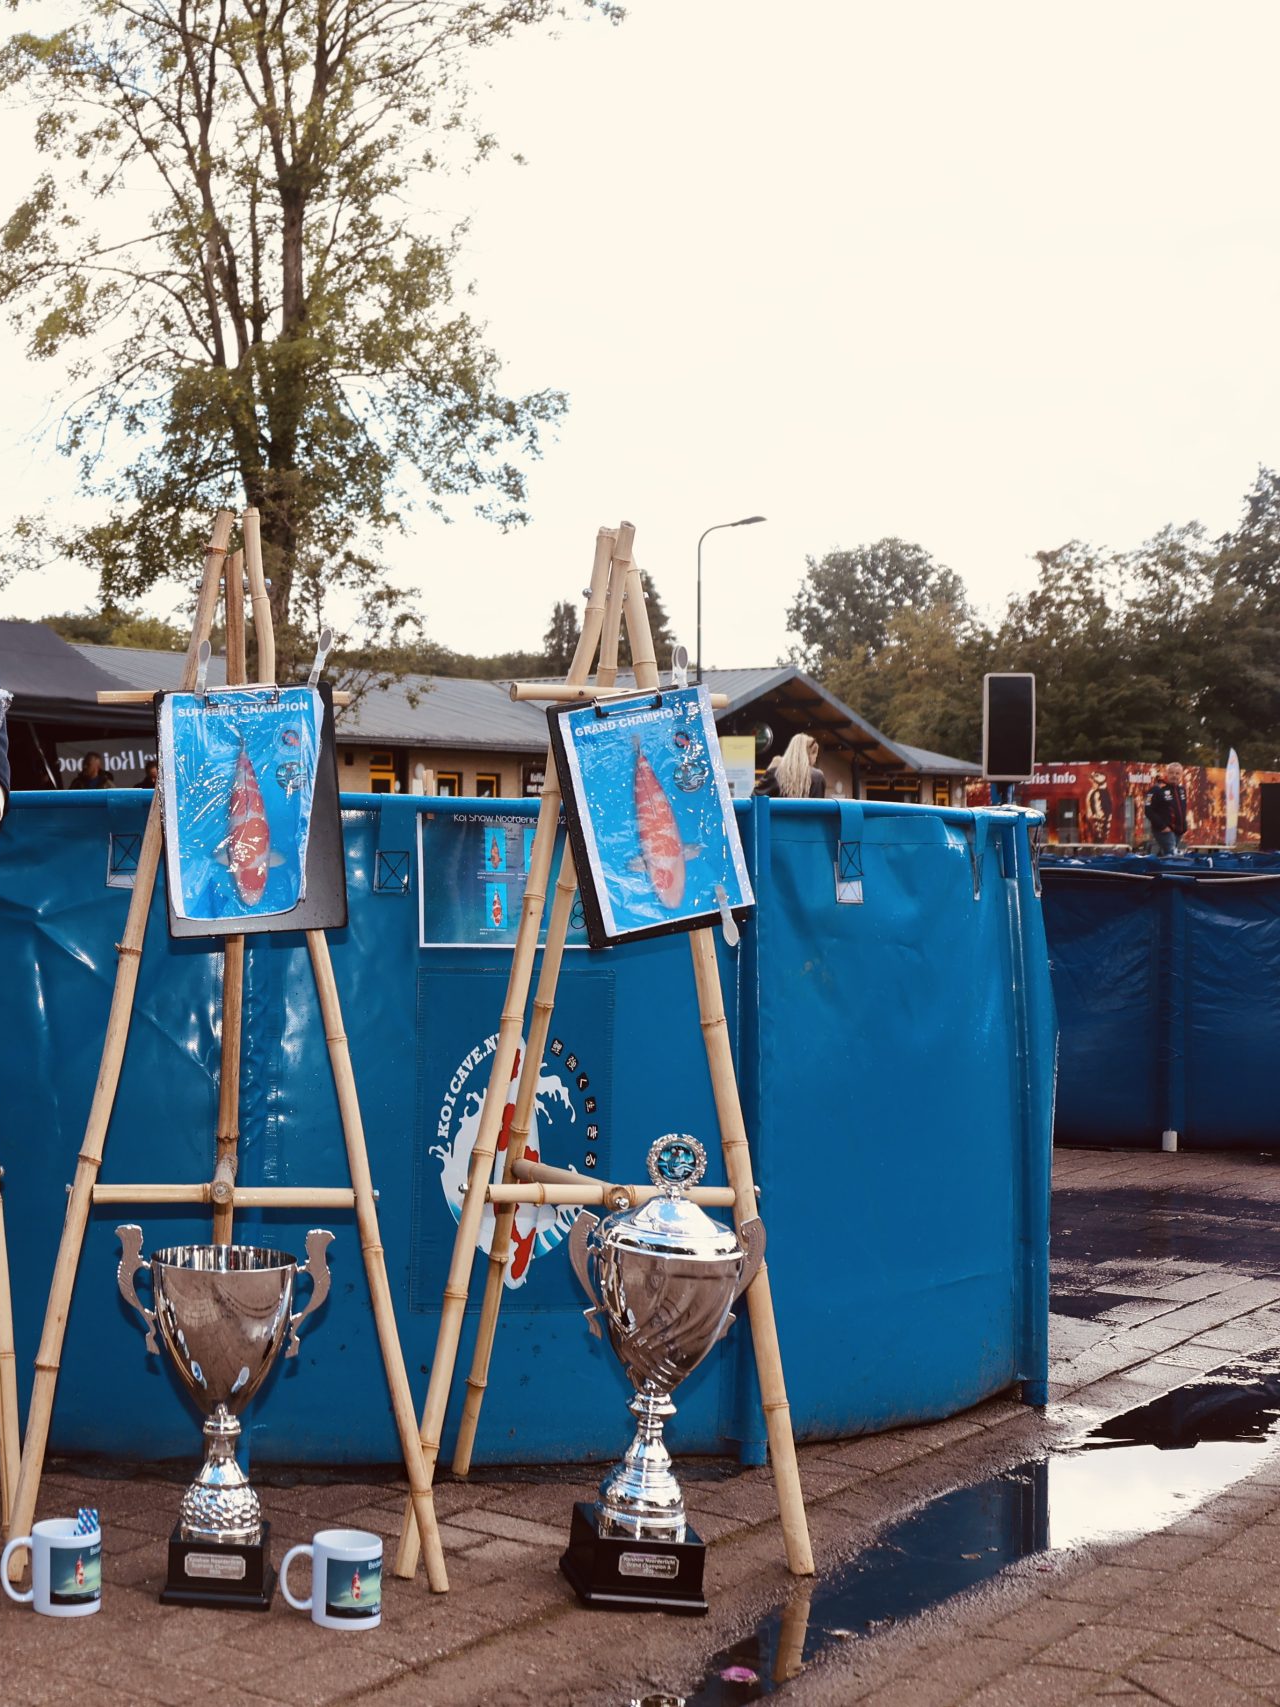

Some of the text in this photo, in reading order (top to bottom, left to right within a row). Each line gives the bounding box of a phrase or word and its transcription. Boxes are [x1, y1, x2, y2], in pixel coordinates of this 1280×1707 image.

[177, 701, 309, 717] SUPREME CHAMPION
[574, 721, 616, 737] GRAND
[619, 707, 683, 727] CHAMPION
[1052, 771, 1077, 784] Info
